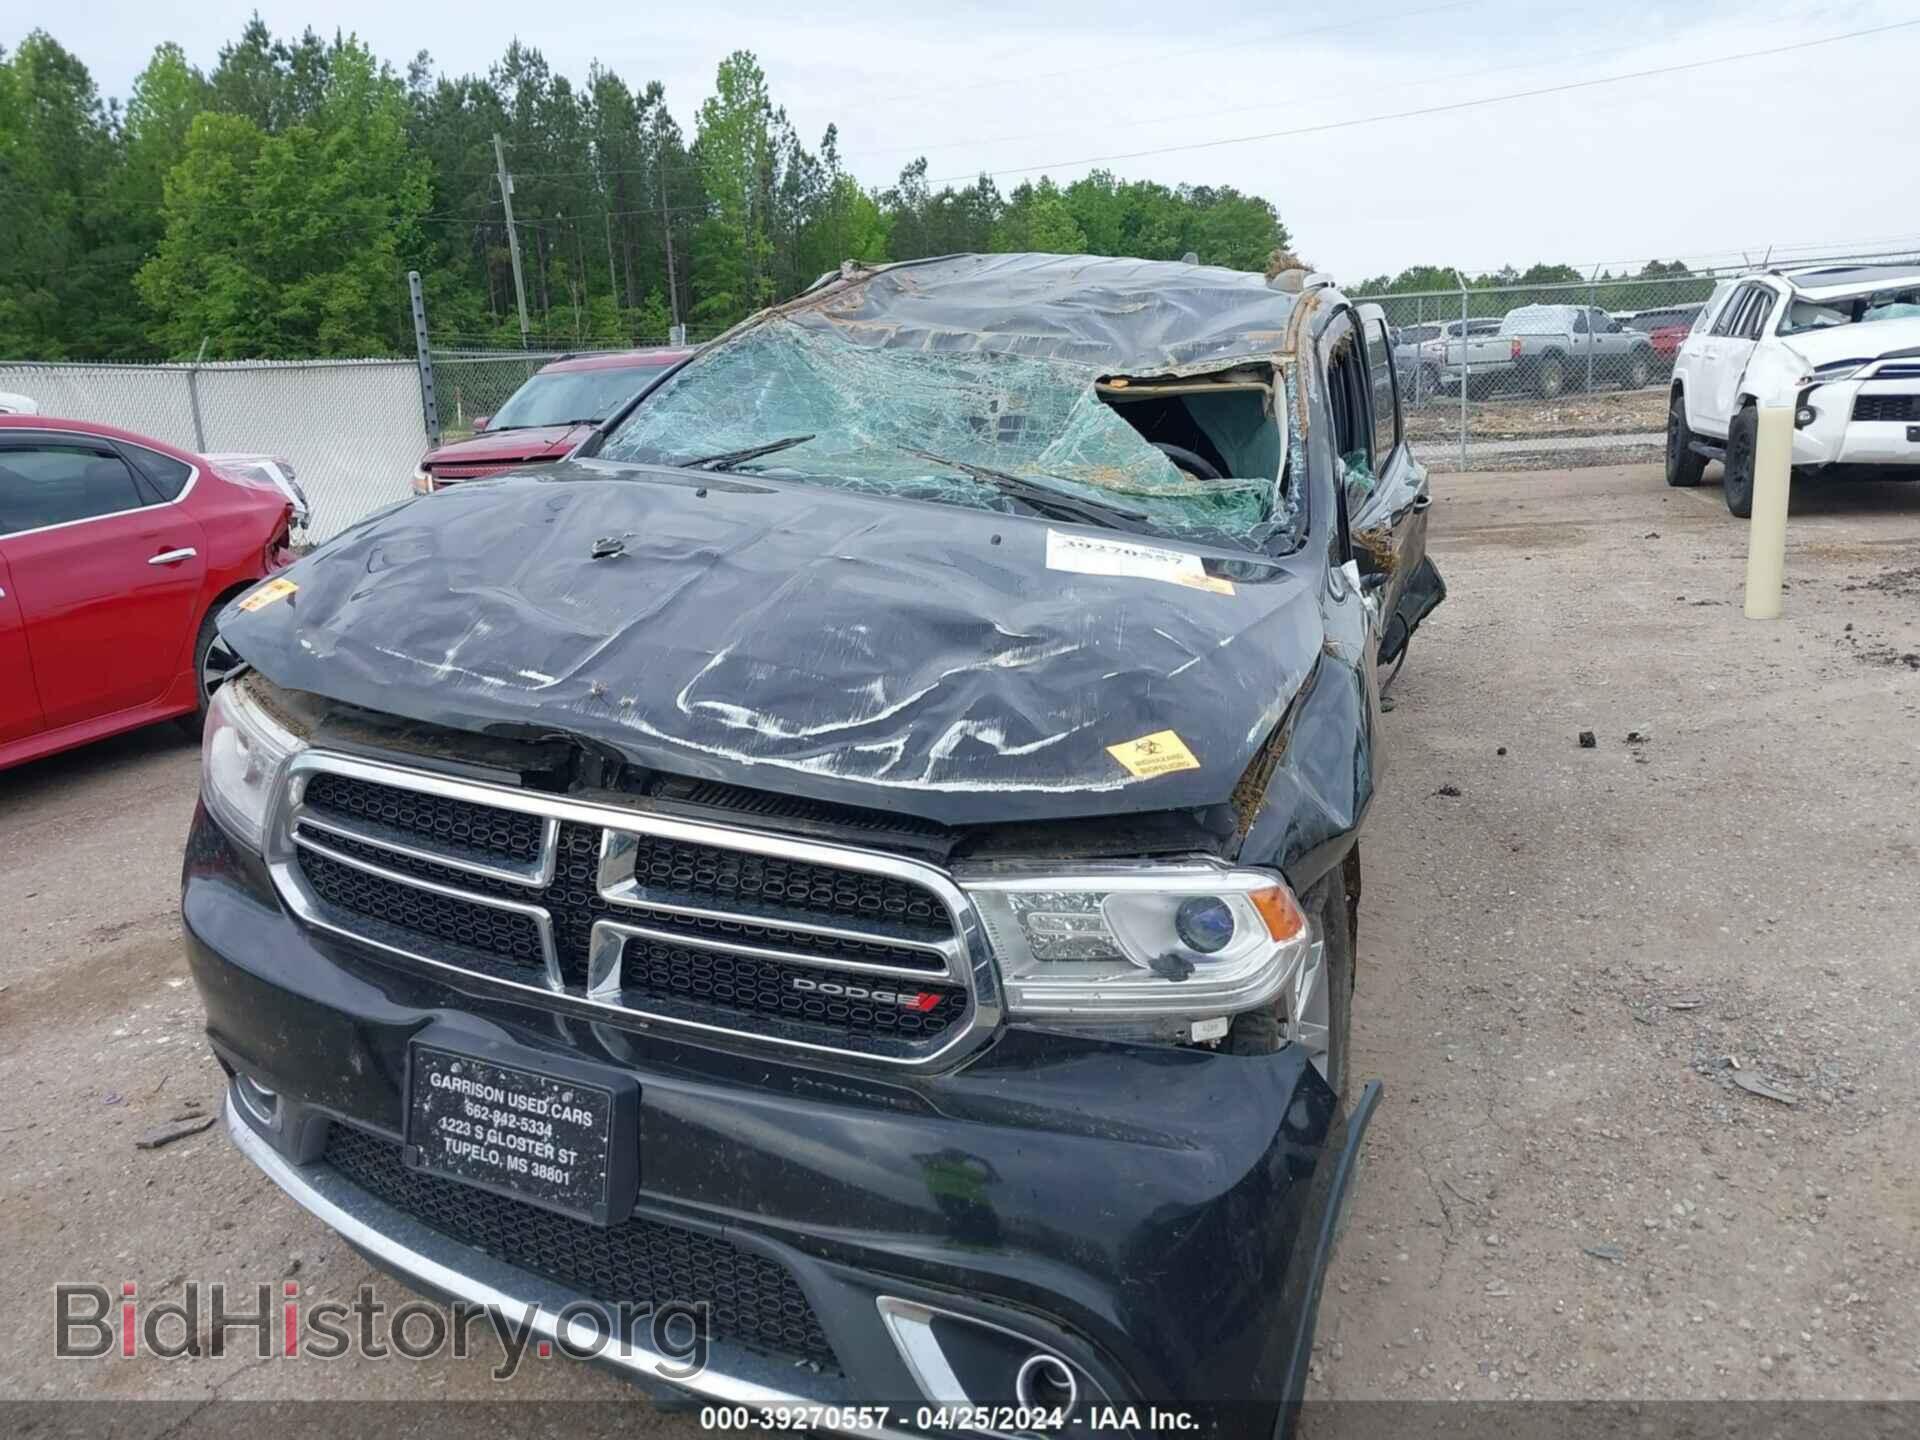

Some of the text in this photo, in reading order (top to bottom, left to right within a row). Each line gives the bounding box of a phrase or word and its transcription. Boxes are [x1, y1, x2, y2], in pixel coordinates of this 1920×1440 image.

[792, 977, 922, 1007] DODGE
[430, 1072, 593, 1127] GARRISON USED CARS
[465, 1101, 553, 1138] 662-842-5334
[443, 1136, 570, 1186] TUPELO, MS 38801
[474, 1124, 484, 1140] S
[487, 1128, 555, 1160] GLOSTER
[558, 1147, 578, 1166] ST
